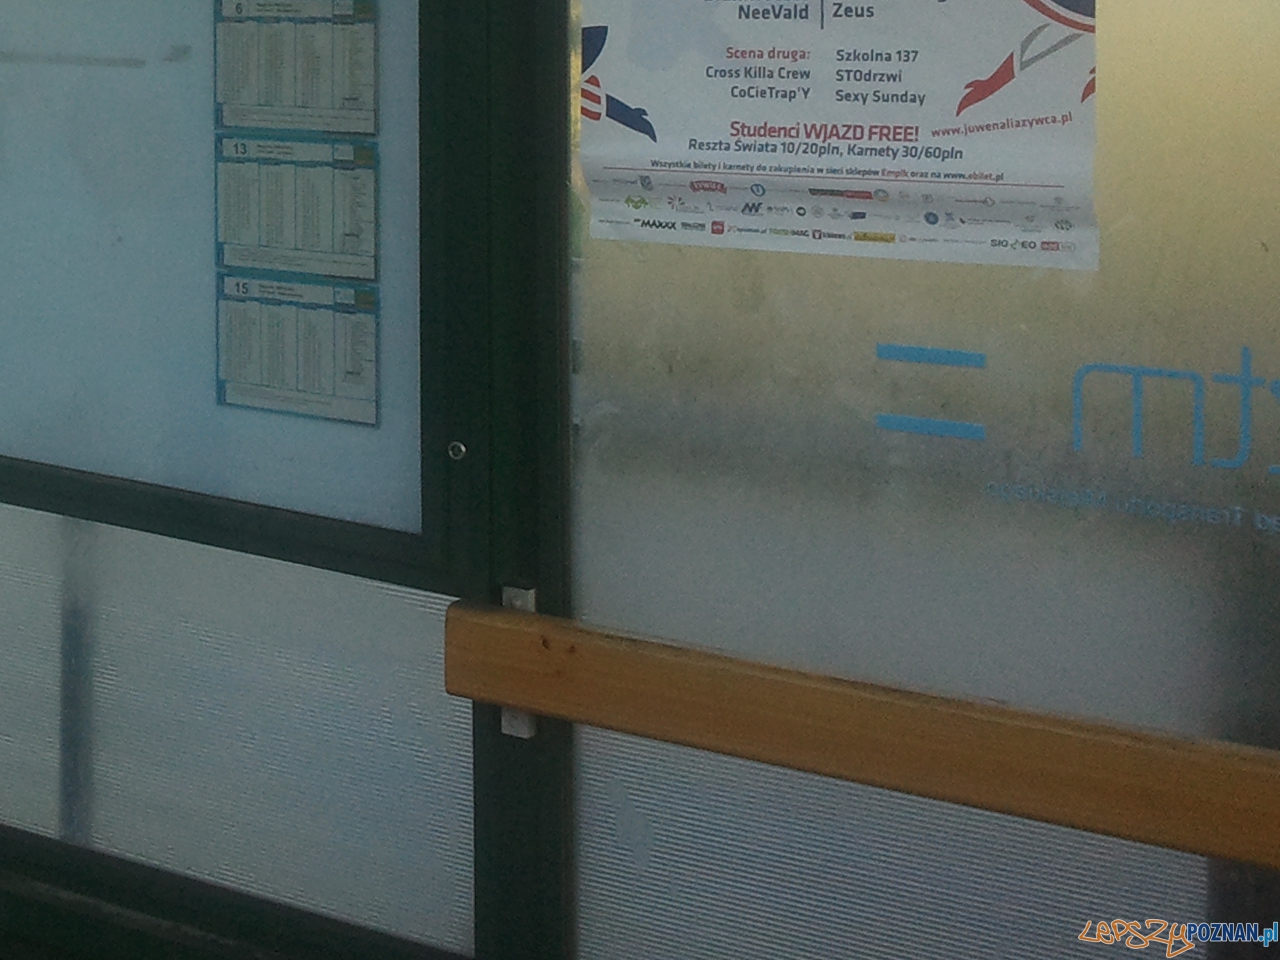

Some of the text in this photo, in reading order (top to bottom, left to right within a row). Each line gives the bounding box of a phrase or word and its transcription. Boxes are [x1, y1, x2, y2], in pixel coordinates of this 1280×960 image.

[235, 2, 243, 15] 6
[738, 3, 809, 21] NeeVald
[832, 3, 875, 19] Zeus
[726, 46, 811, 65] Scena druga:
[836, 48, 919, 63] Szkolna 137
[705, 66, 811, 80] Cross Killa Crew
[835, 90, 926, 107] Sexy Sunday
[729, 120, 920, 144] Studenci WJAZD FREE!
[931, 111, 1073, 138] www.juwenaliazywca.pl
[233, 142, 248, 155] 13
[688, 138, 964, 161] Reszta Świata 10/20pln, Karnety 30/60pln
[650, 159, 691, 169] Wszystkie
[693, 161, 716, 171] bilety
[723, 162, 754, 172] karnety
[756, 164, 767, 172] do
[910, 171, 929, 179] oraz
[931, 172, 942, 180] na
[235, 282, 249, 295] 15
